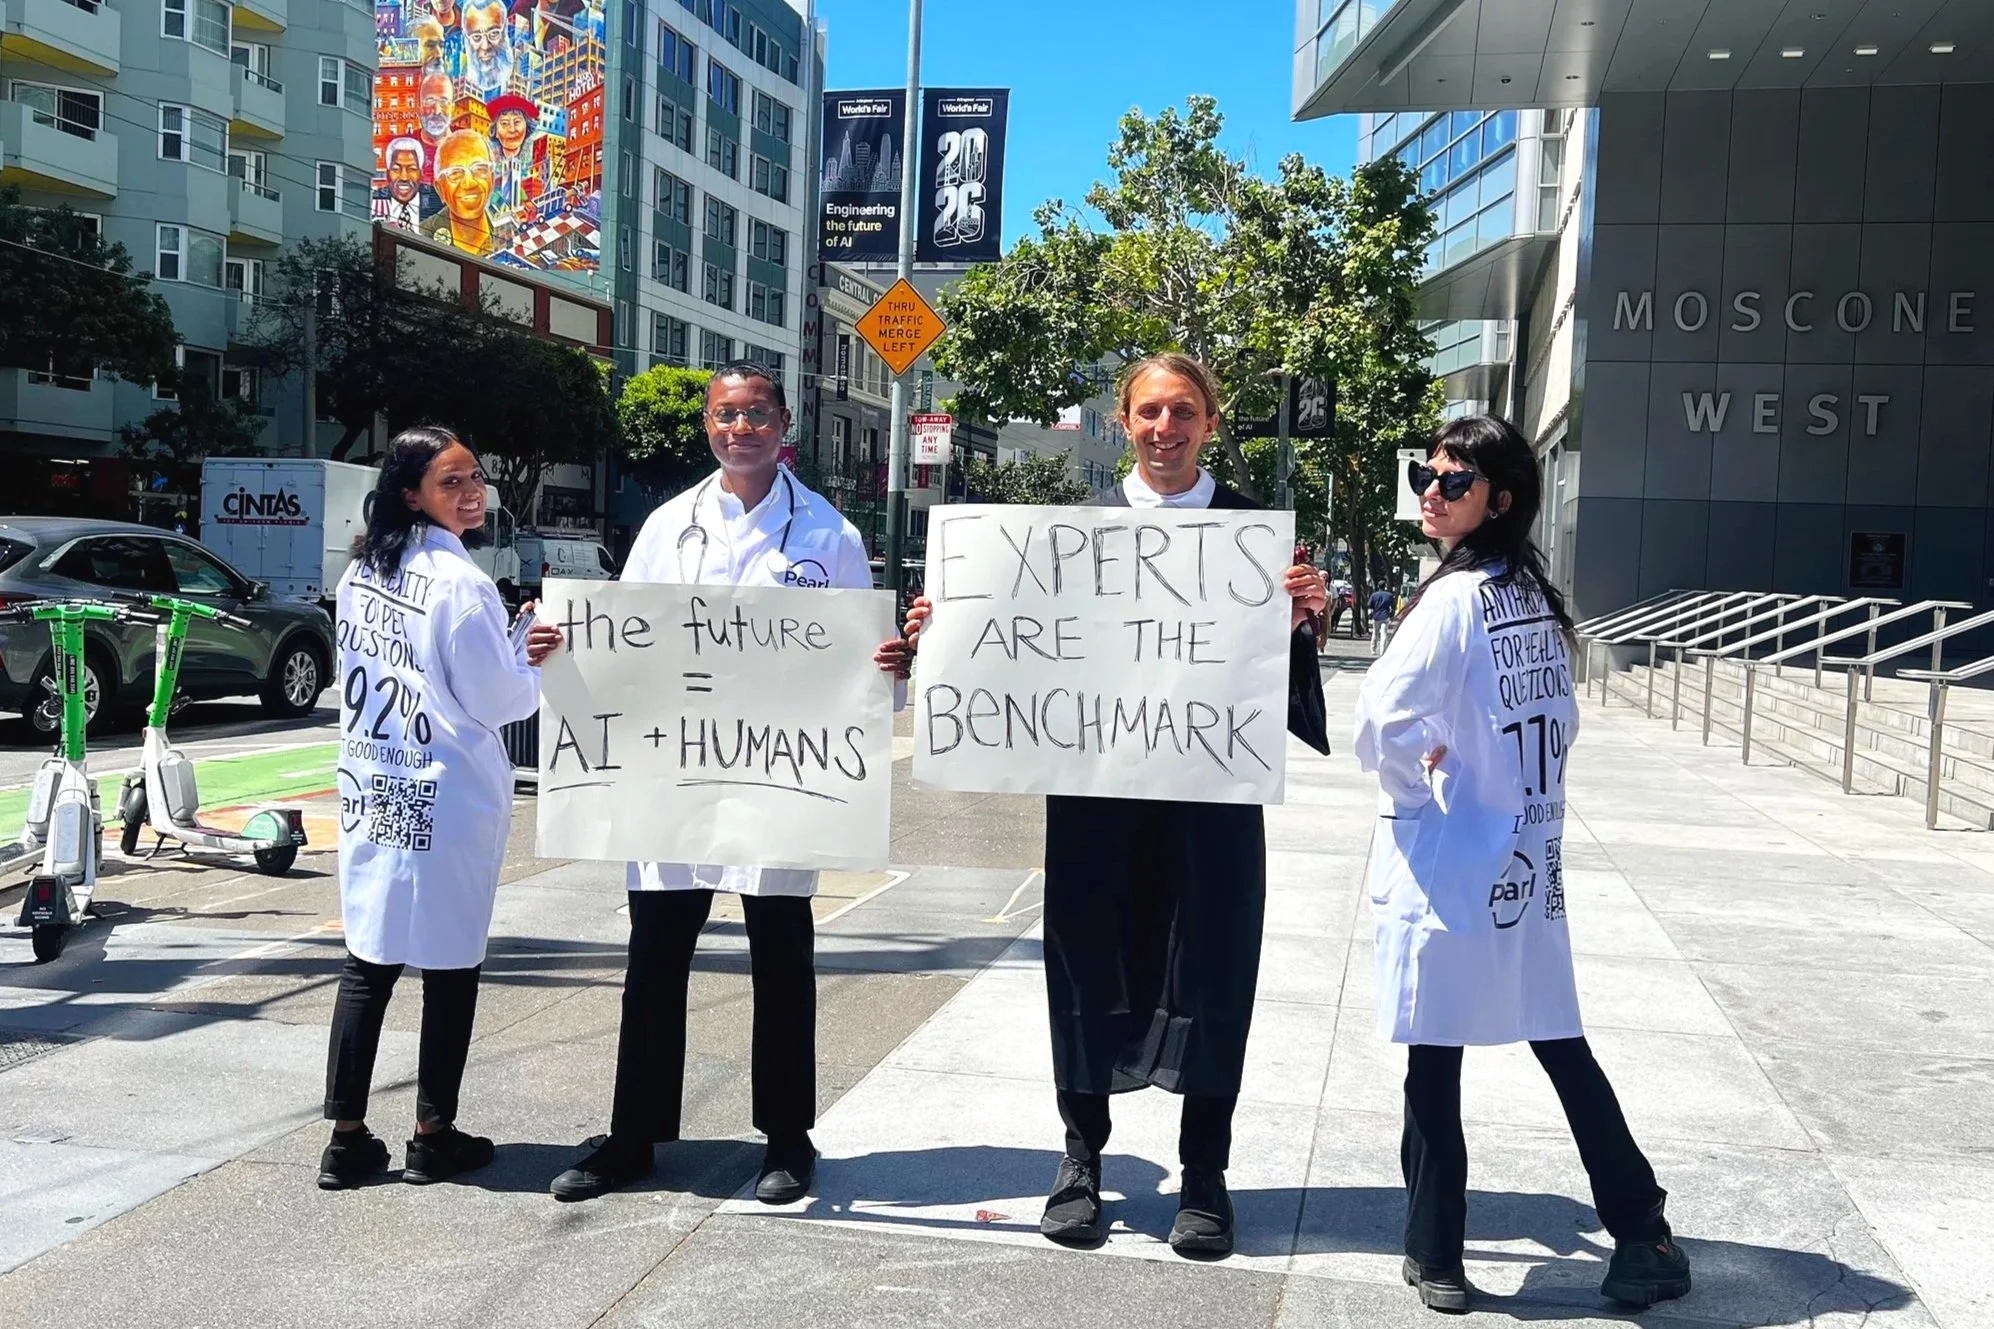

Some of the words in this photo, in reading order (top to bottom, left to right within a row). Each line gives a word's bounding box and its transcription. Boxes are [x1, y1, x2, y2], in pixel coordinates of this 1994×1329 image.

[842, 105, 871, 115] World's
[872, 104, 888, 114] Fair
[942, 103, 972, 113] World's
[973, 103, 988, 112] Fair
[935, 127, 988, 188] 20
[826, 203, 895, 218] Engineering
[933, 181, 987, 247] 26
[826, 220, 846, 231] the
[847, 220, 882, 231] future
[826, 236, 838, 247] of
[840, 236, 852, 247] AI
[839, 275, 871, 304] CENTRAL
[888, 302, 915, 311] THRU
[1612, 290, 1976, 333] MOSCONE
[878, 315, 923, 325] TRAFFIC
[878, 329, 921, 338] MERGE
[883, 342, 915, 352] LEFT
[1681, 391, 1890, 436] WEST
[911, 424, 921, 434] NO
[923, 425, 949, 433] STOPPING
[921, 445, 938, 454] TIME
[922, 435, 938, 444] ANY
[937, 514, 1276, 607] EXPERTS
[382, 604, 408, 639] PET
[556, 598, 657, 653] the
[971, 616, 1086, 662] ARE
[1123, 619, 1226, 665] THE
[1490, 634, 1524, 670] FOR
[682, 672, 712, 692] =
[349, 740, 378, 760] GOOD
[380, 745, 433, 769] ENOUGH
[549, 713, 623, 773] AI
[643, 726, 667, 747] +
[680, 716, 866, 785] HUMANS
